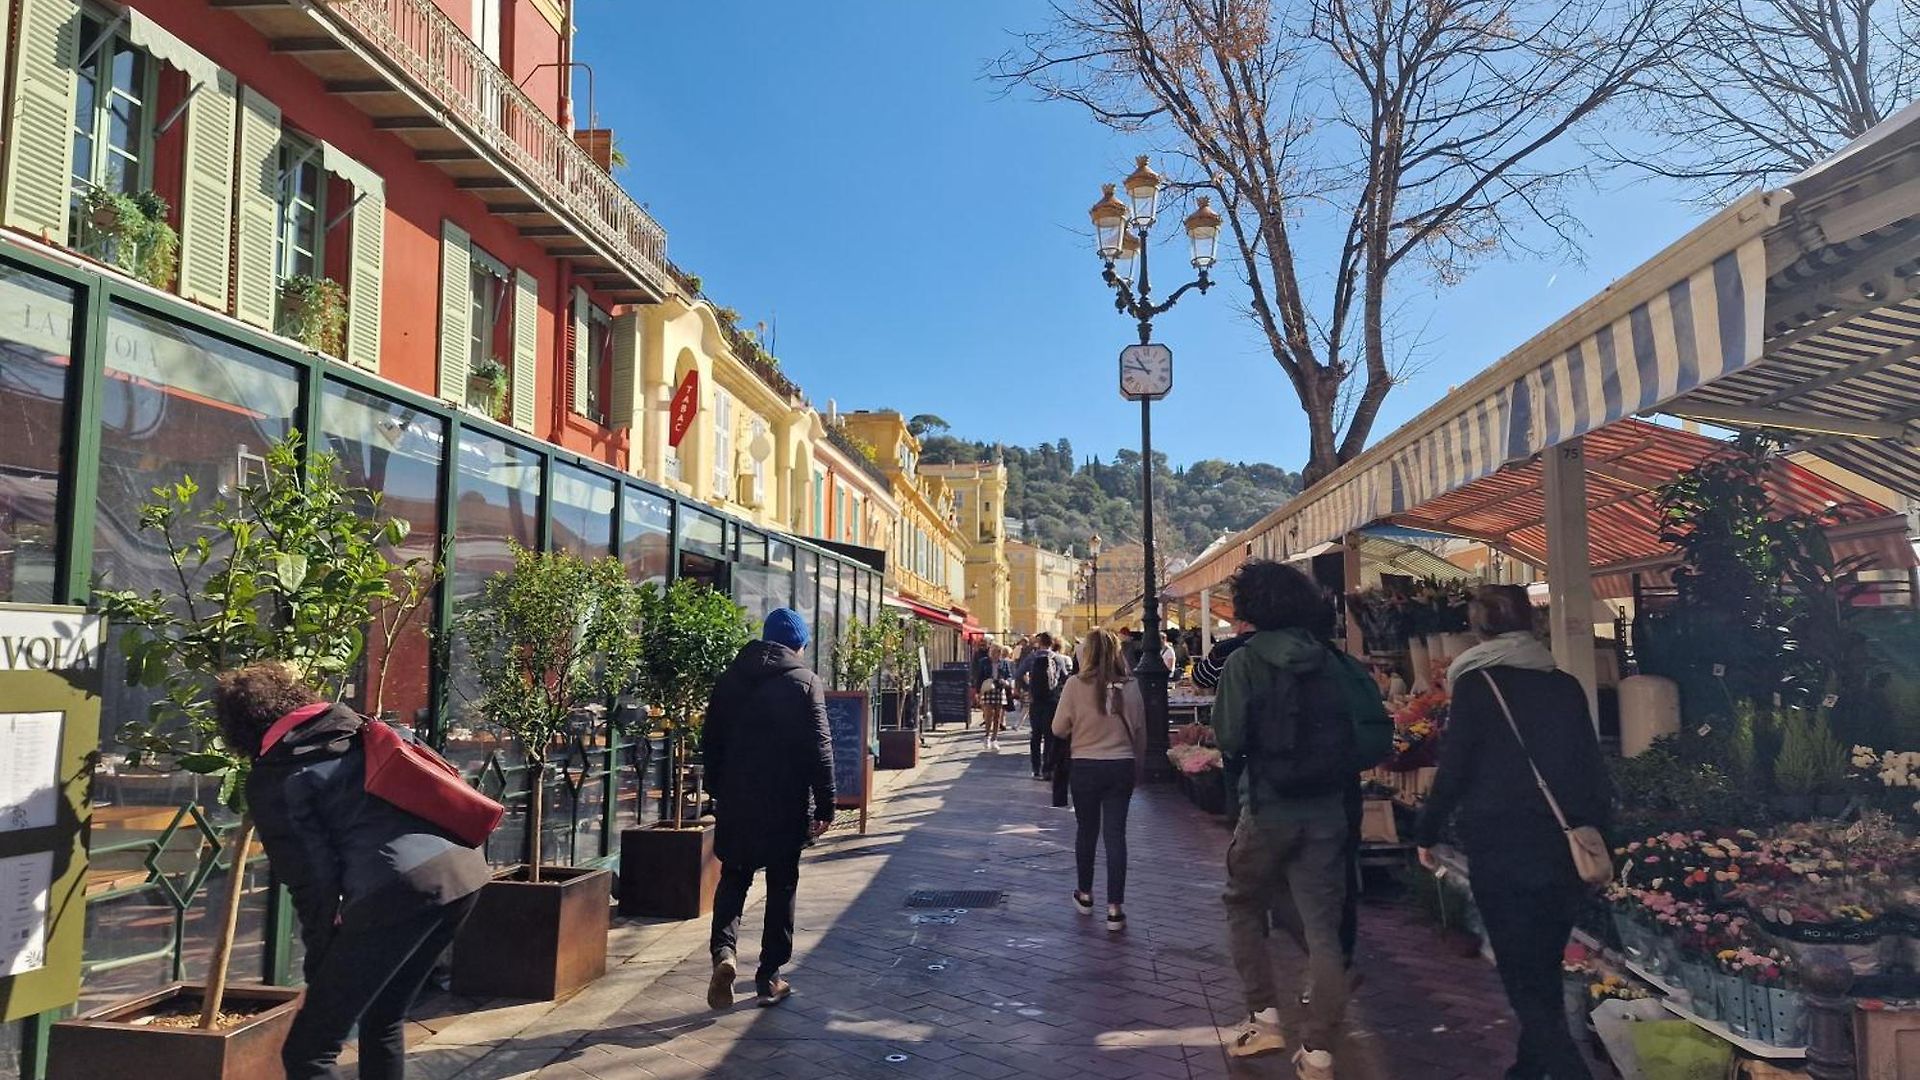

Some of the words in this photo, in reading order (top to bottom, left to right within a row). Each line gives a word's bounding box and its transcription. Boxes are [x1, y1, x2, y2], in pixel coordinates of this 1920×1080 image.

[111, 332, 160, 368] OLA
[675, 385, 693, 432] TABAC
[1563, 448, 1578, 459] 75
[2, 636, 95, 670] VOLA
